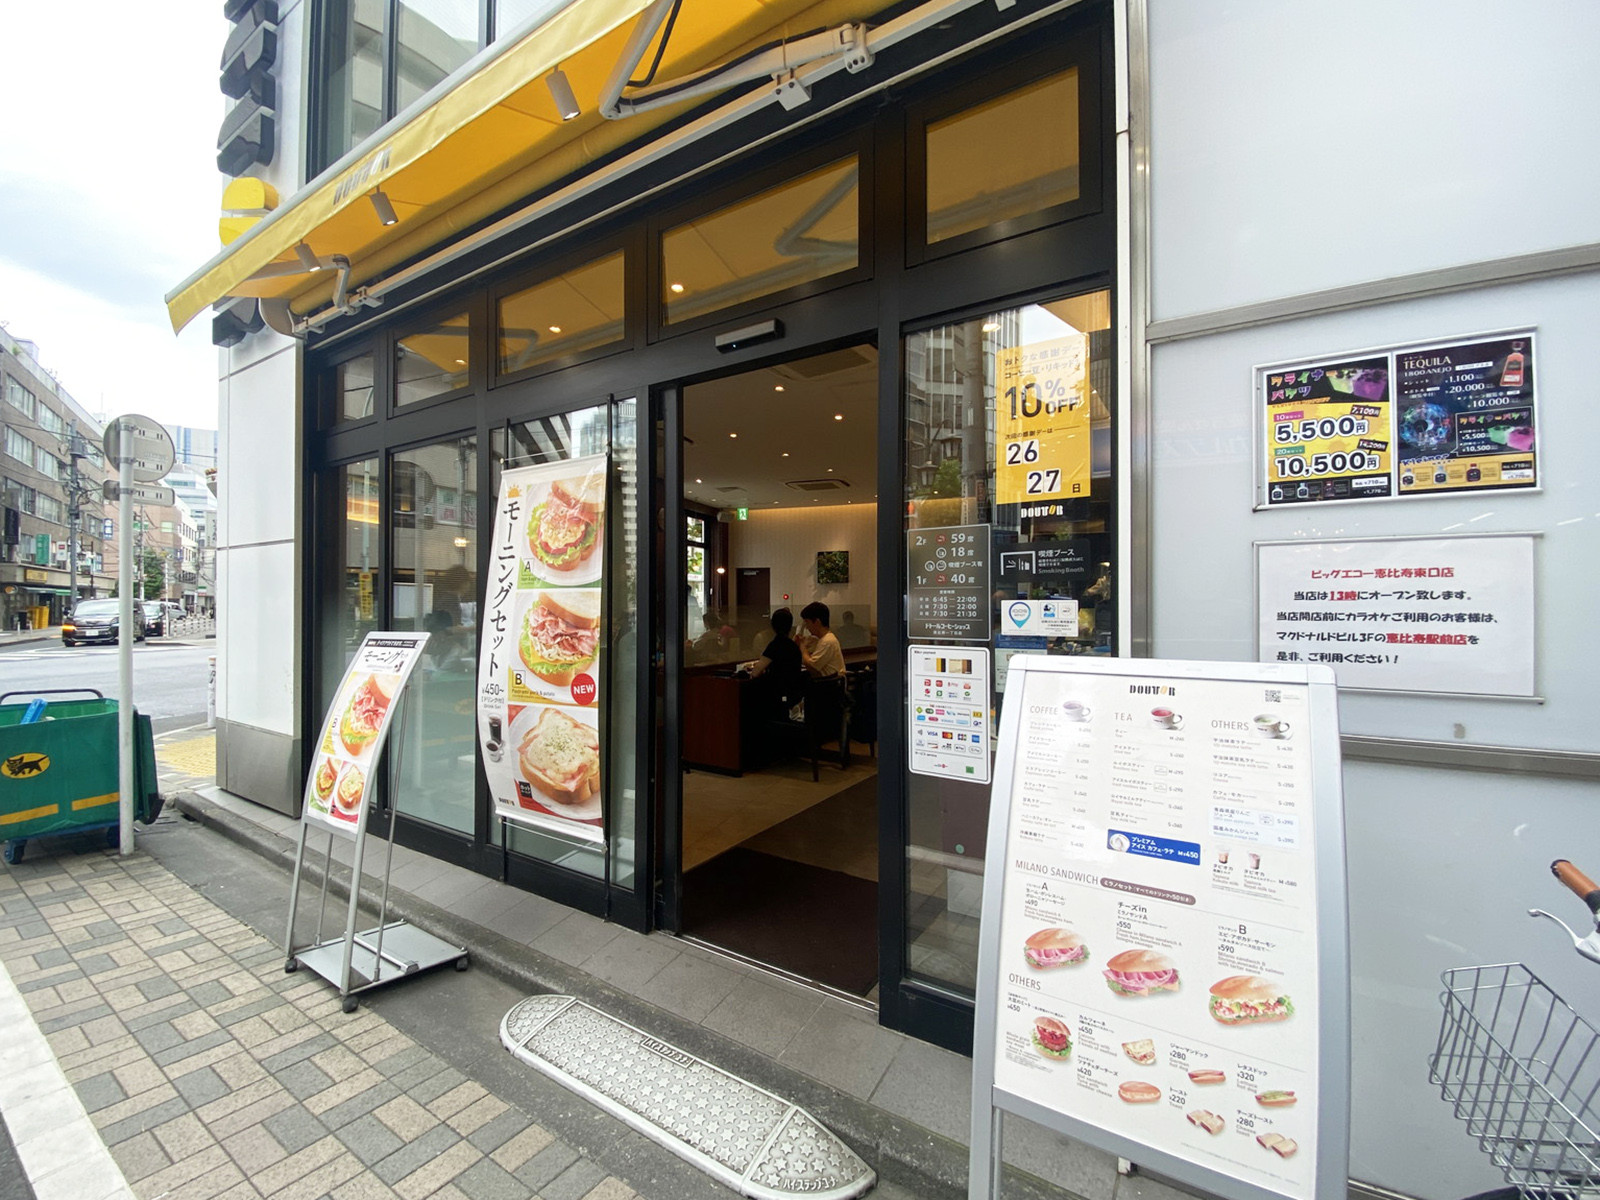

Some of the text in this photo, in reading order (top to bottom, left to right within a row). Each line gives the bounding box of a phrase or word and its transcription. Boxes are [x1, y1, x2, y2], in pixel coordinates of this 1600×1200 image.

[1403, 356, 1451, 369] TEQUILA
[1045, 396, 1079, 414] OFF
[1005, 428, 1053, 440] 次回の感謝デーは
[1008, 441, 1037, 465] 26
[1401, 453, 1449, 466] Kleiner
[1028, 469, 1060, 494] 27
[1072, 483, 1081, 493] 日
[1021, 505, 1064, 518] DOUTOR
[916, 536, 927, 545] 2F
[951, 533, 966, 543] 59
[951, 547, 966, 557] 18
[1038, 549, 1075, 557] 喫煙ブース
[524, 561, 531, 572] A
[1311, 567, 1454, 579] ビッグエコー恵比寿東口店
[916, 575, 927, 585] 1F
[950, 574, 966, 583] 40
[490, 501, 520, 678] モーニングセット
[1294, 590, 1471, 601] 当店は13時にオープン致します。
[1276, 611, 1498, 623] 当店開店前にカラオケご利用のお客様は、
[1276, 631, 1479, 645] マクドナルドビル3Fの恵比寿駅前店を
[1276, 651, 1399, 664] 是非、ご利用ください！
[515, 673, 522, 685] B
[573, 683, 594, 694] NEW
[1129, 684, 1176, 696] DOUTOR
[1030, 705, 1058, 715] COFFEE
[1115, 712, 1133, 721] TEA
[1211, 720, 1249, 731] OTHERS
[1131, 836, 1156, 845] プレミアム
[1131, 842, 1146, 850] アイス
[1147, 845, 1175, 855] カフェ・ラテ
[1015, 859, 1099, 885] MILANO SANDWICH
[1041, 882, 1048, 891] A
[1118, 901, 1147, 913] チーズin
[1238, 924, 1247, 934] B
[1008, 973, 1041, 991] OTHERS
